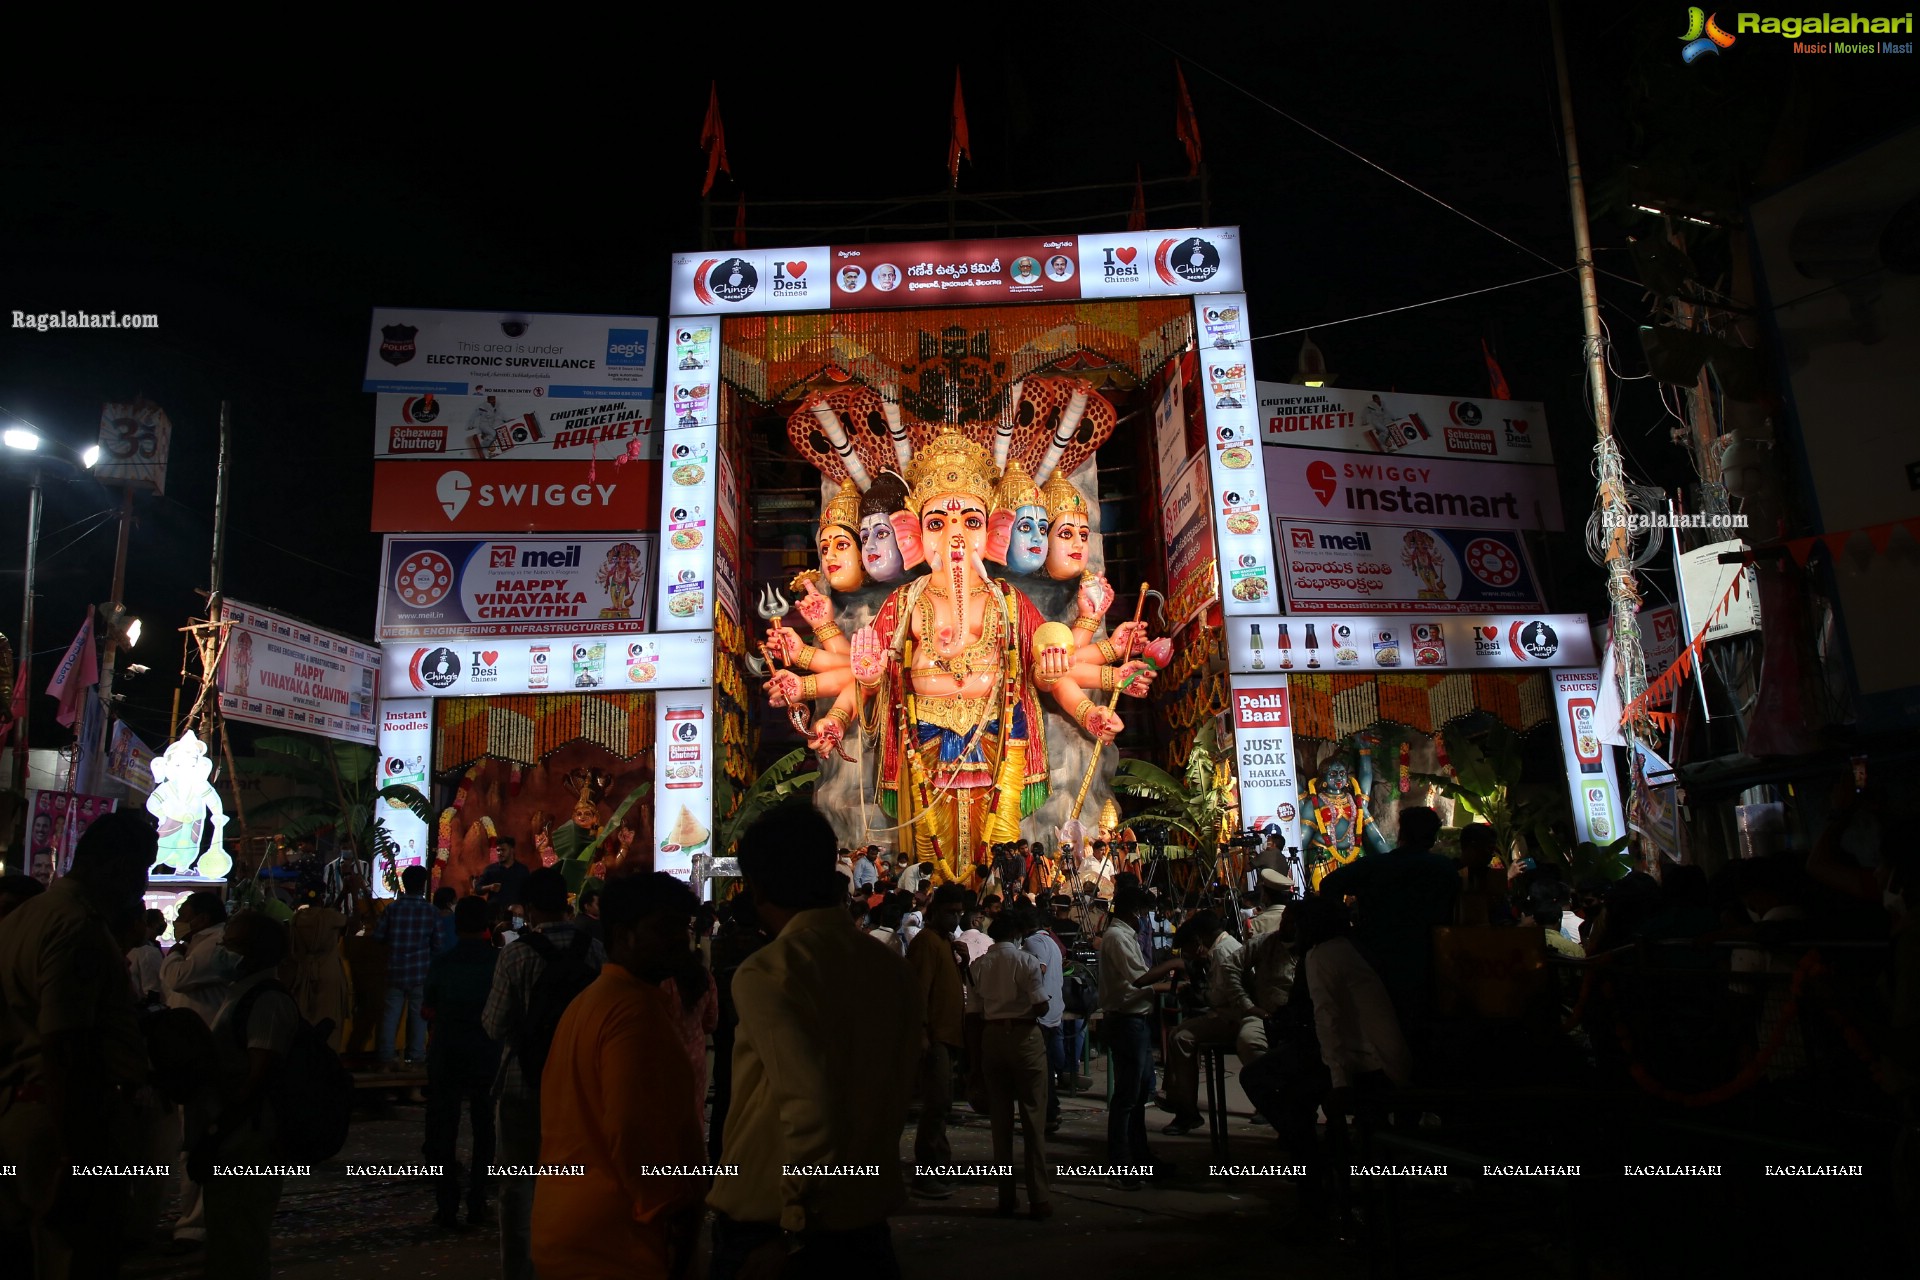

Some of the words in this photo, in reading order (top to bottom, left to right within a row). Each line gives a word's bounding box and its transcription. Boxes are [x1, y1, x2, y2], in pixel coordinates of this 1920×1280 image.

[970, 258, 1002, 274] కమిటీ
[1104, 264, 1139, 277] Desi
[1175, 264, 1218, 276] Ching's
[712, 284, 755, 296] Ching's
[773, 278, 808, 290] Desi
[773, 290, 808, 298] Chinese
[382, 343, 415, 352] POLICE
[457, 341, 481, 353] This
[484, 343, 513, 354] area
[515, 342, 526, 354] is
[526, 343, 564, 355] under
[610, 342, 645, 358] aegis
[426, 354, 503, 368] ELECTRONIC
[505, 356, 596, 370] SURVEILLANCE
[1261, 396, 1302, 407] CHUTNEY
[1303, 395, 1329, 405] NAHI.
[550, 405, 597, 422] CHUTNEY
[598, 401, 627, 414] NAHI.
[1277, 405, 1321, 417] ROCKET
[1321, 403, 1345, 414] HAI.
[564, 413, 616, 431] ROCKET
[616, 409, 643, 422] HAI.
[1269, 412, 1355, 434] ROCKET!
[393, 427, 444, 439] Schezwan
[552, 417, 653, 450] ROCKET!
[1447, 428, 1492, 442] Schezwan
[1505, 432, 1532, 443] Desi
[392, 437, 443, 452] Chutney
[1447, 437, 1493, 454] Chutney
[1343, 463, 1431, 483] SWIGGY
[477, 484, 617, 506] SWIGGY
[1345, 485, 1520, 520] instamart
[1320, 531, 1372, 551] meil
[521, 545, 582, 568] meil
[1291, 560, 1354, 574] వినాయక
[1356, 562, 1393, 575] చవితి
[495, 579, 568, 592] HAPPY
[1293, 576, 1384, 595] శుభాకాంక్షలు
[474, 592, 588, 606] VINAYAKA
[397, 611, 444, 621] www.meil.in
[477, 606, 579, 619] CHAVITHI
[382, 626, 420, 637] MEGHA
[421, 625, 497, 636] ENGINEERING
[499, 625, 508, 634] &
[510, 622, 615, 634] INFRASTRUCTURES
[617, 621, 641, 631] LTD.
[1475, 640, 1501, 651] Desi
[1525, 644, 1557, 654] Ching's
[294, 662, 325, 682] HAPPY
[424, 671, 458, 683] Ching's
[471, 666, 497, 677] Desi
[1556, 673, 1599, 682] CHINESE
[260, 670, 310, 696] VINAYAKA
[312, 684, 349, 705] CHAVITHI
[1560, 683, 1598, 692] SAUCES
[1239, 693, 1282, 709] Pehli
[385, 711, 428, 721] Instant
[1241, 709, 1281, 723] Baar
[384, 721, 429, 732] Noodles
[1244, 738, 1283, 752] JUST
[670, 751, 699, 760] Chutney
[1243, 752, 1286, 767] SOAK
[1249, 769, 1286, 779] HAKKA
[1243, 779, 1292, 789] NOODLES
